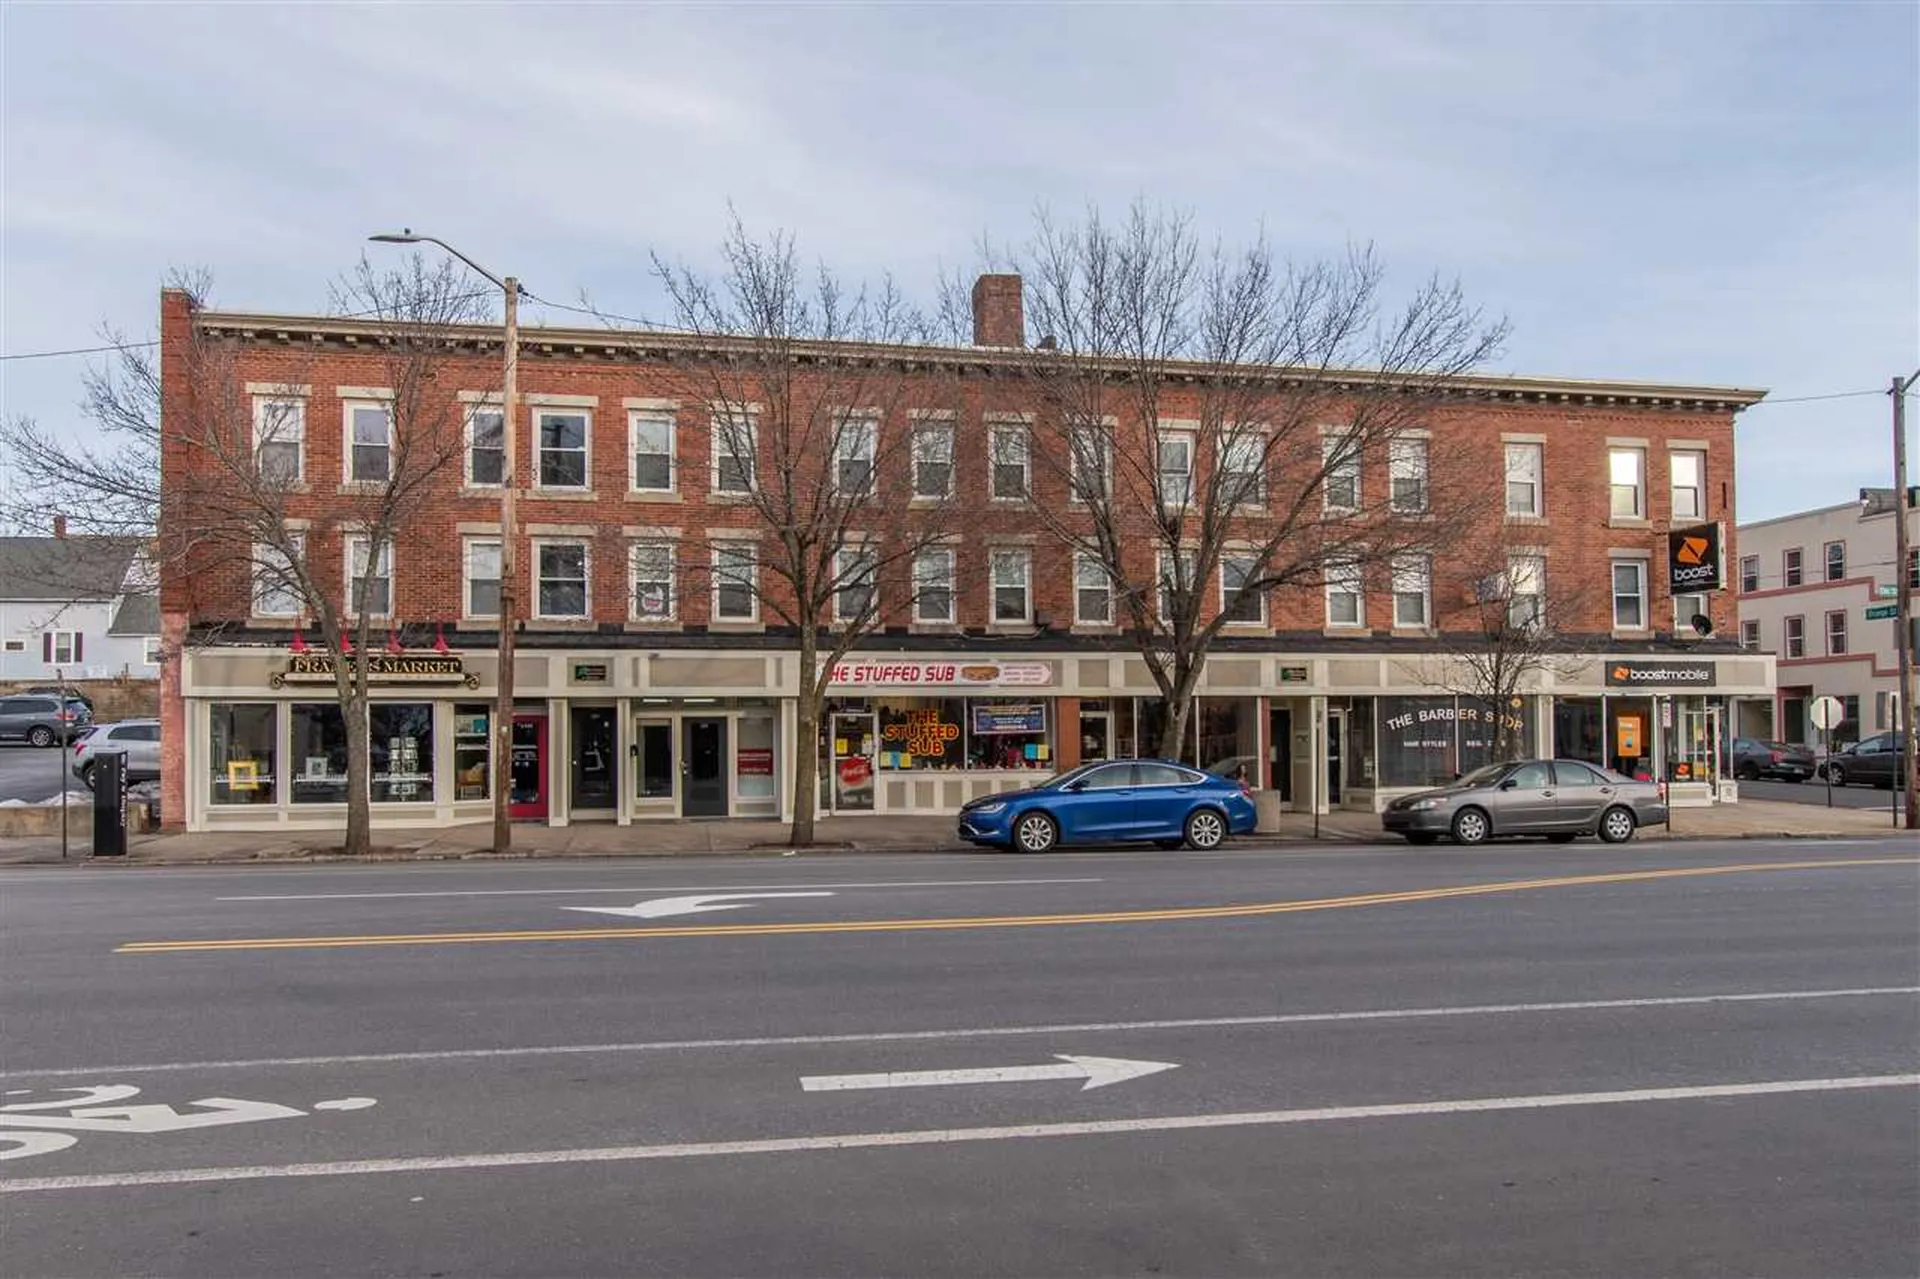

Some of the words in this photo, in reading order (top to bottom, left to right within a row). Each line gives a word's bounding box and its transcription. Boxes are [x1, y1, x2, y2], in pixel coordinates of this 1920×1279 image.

[1674, 564, 1713, 580] boost
[295, 658, 382, 673] FRAES
[383, 658, 458, 673] MARKET
[827, 666, 849, 681] HE
[854, 665, 920, 681] STUFFED
[925, 665, 955, 681] SUB
[905, 710, 937, 723] THE
[1386, 713, 1414, 731] THE
[1418, 708, 1477, 722] BARBER
[884, 724, 959, 740] STUFFED
[908, 738, 944, 756] SUB
